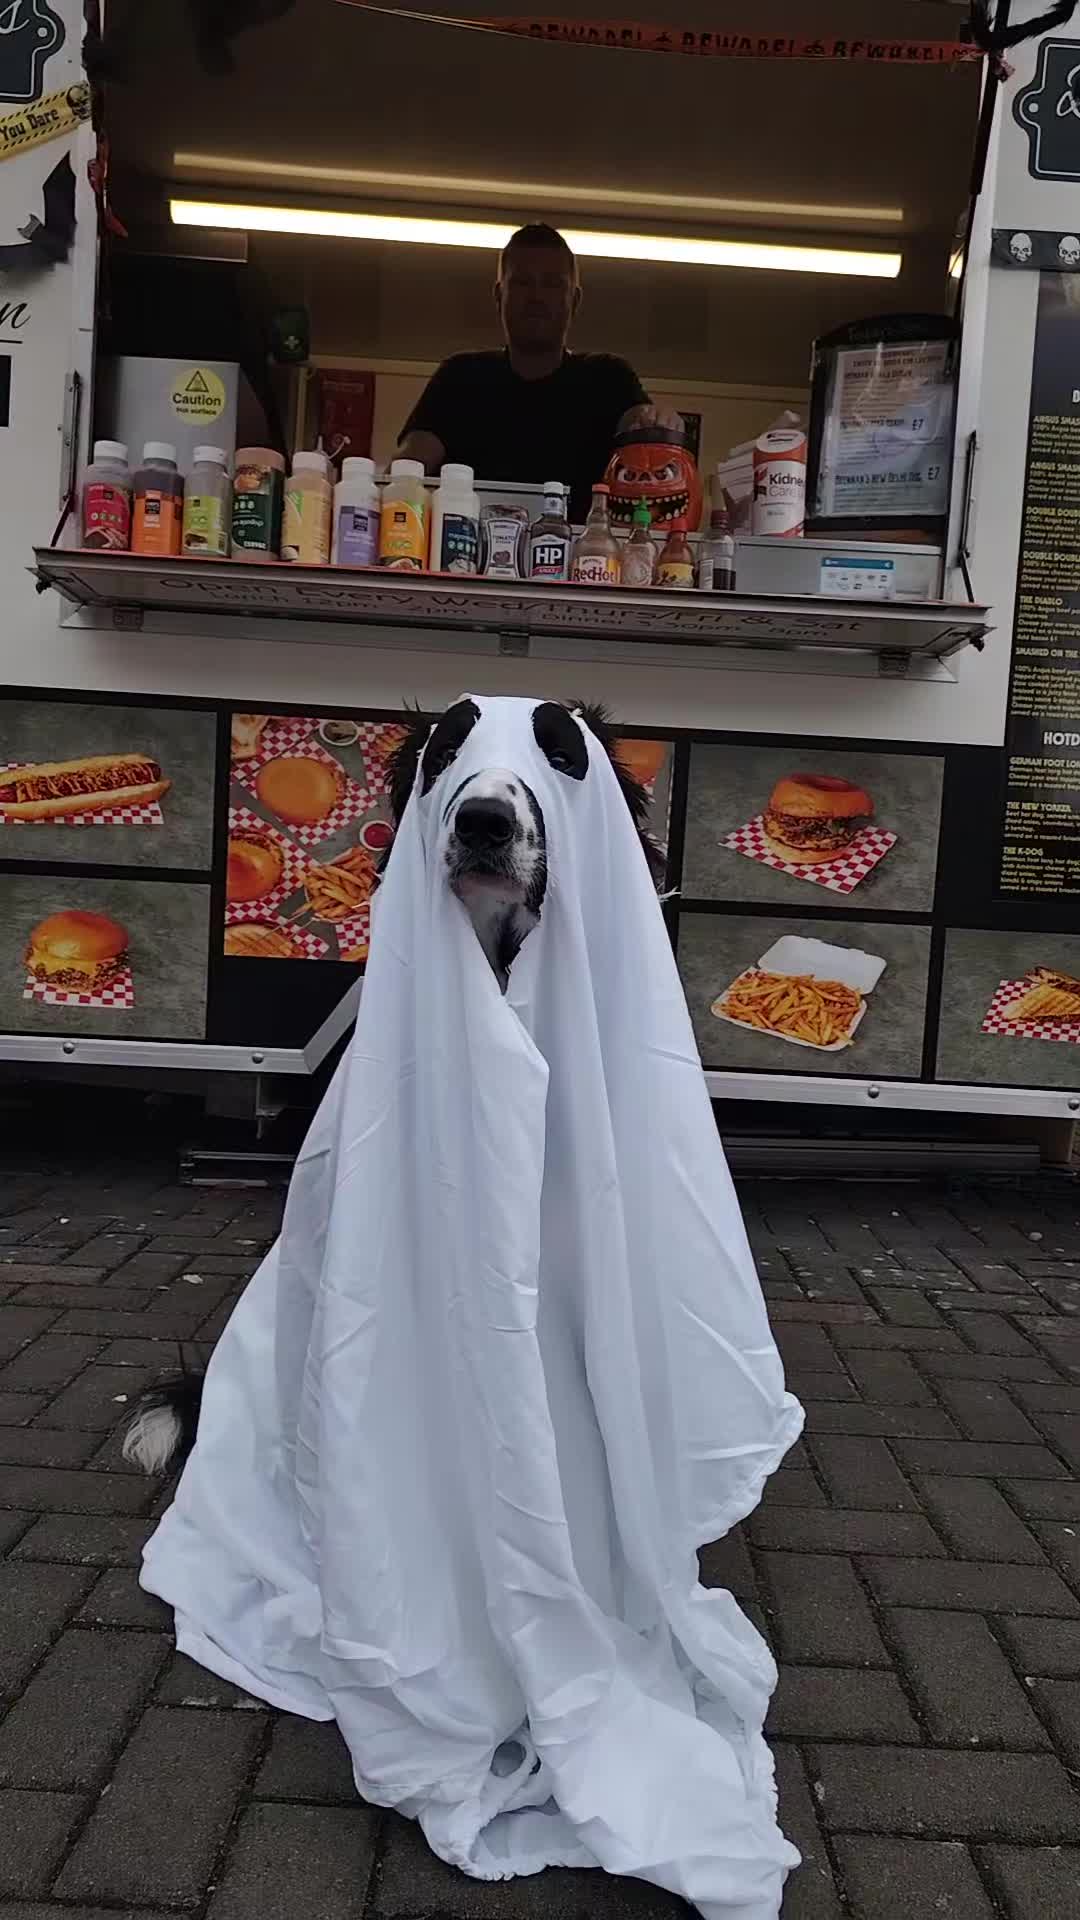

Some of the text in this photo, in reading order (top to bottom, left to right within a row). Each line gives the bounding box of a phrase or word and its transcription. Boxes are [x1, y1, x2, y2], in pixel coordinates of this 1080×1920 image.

[0, 109, 59, 141] You Dare
[173, 393, 221, 406] Caution
[535, 546, 563, 565] HP
[574, 566, 615, 582] RedHot
[160, 578, 278, 595] Open
[296, 586, 413, 605] Every
[740, 615, 773, 625] &
[791, 616, 865, 631] Sat
[208, 591, 289, 604] Lunch
[541, 613, 625, 626] Dinner
[1043, 731, 1080, 746] HOTD
[1017, 847, 1044, 858] K-DOG
